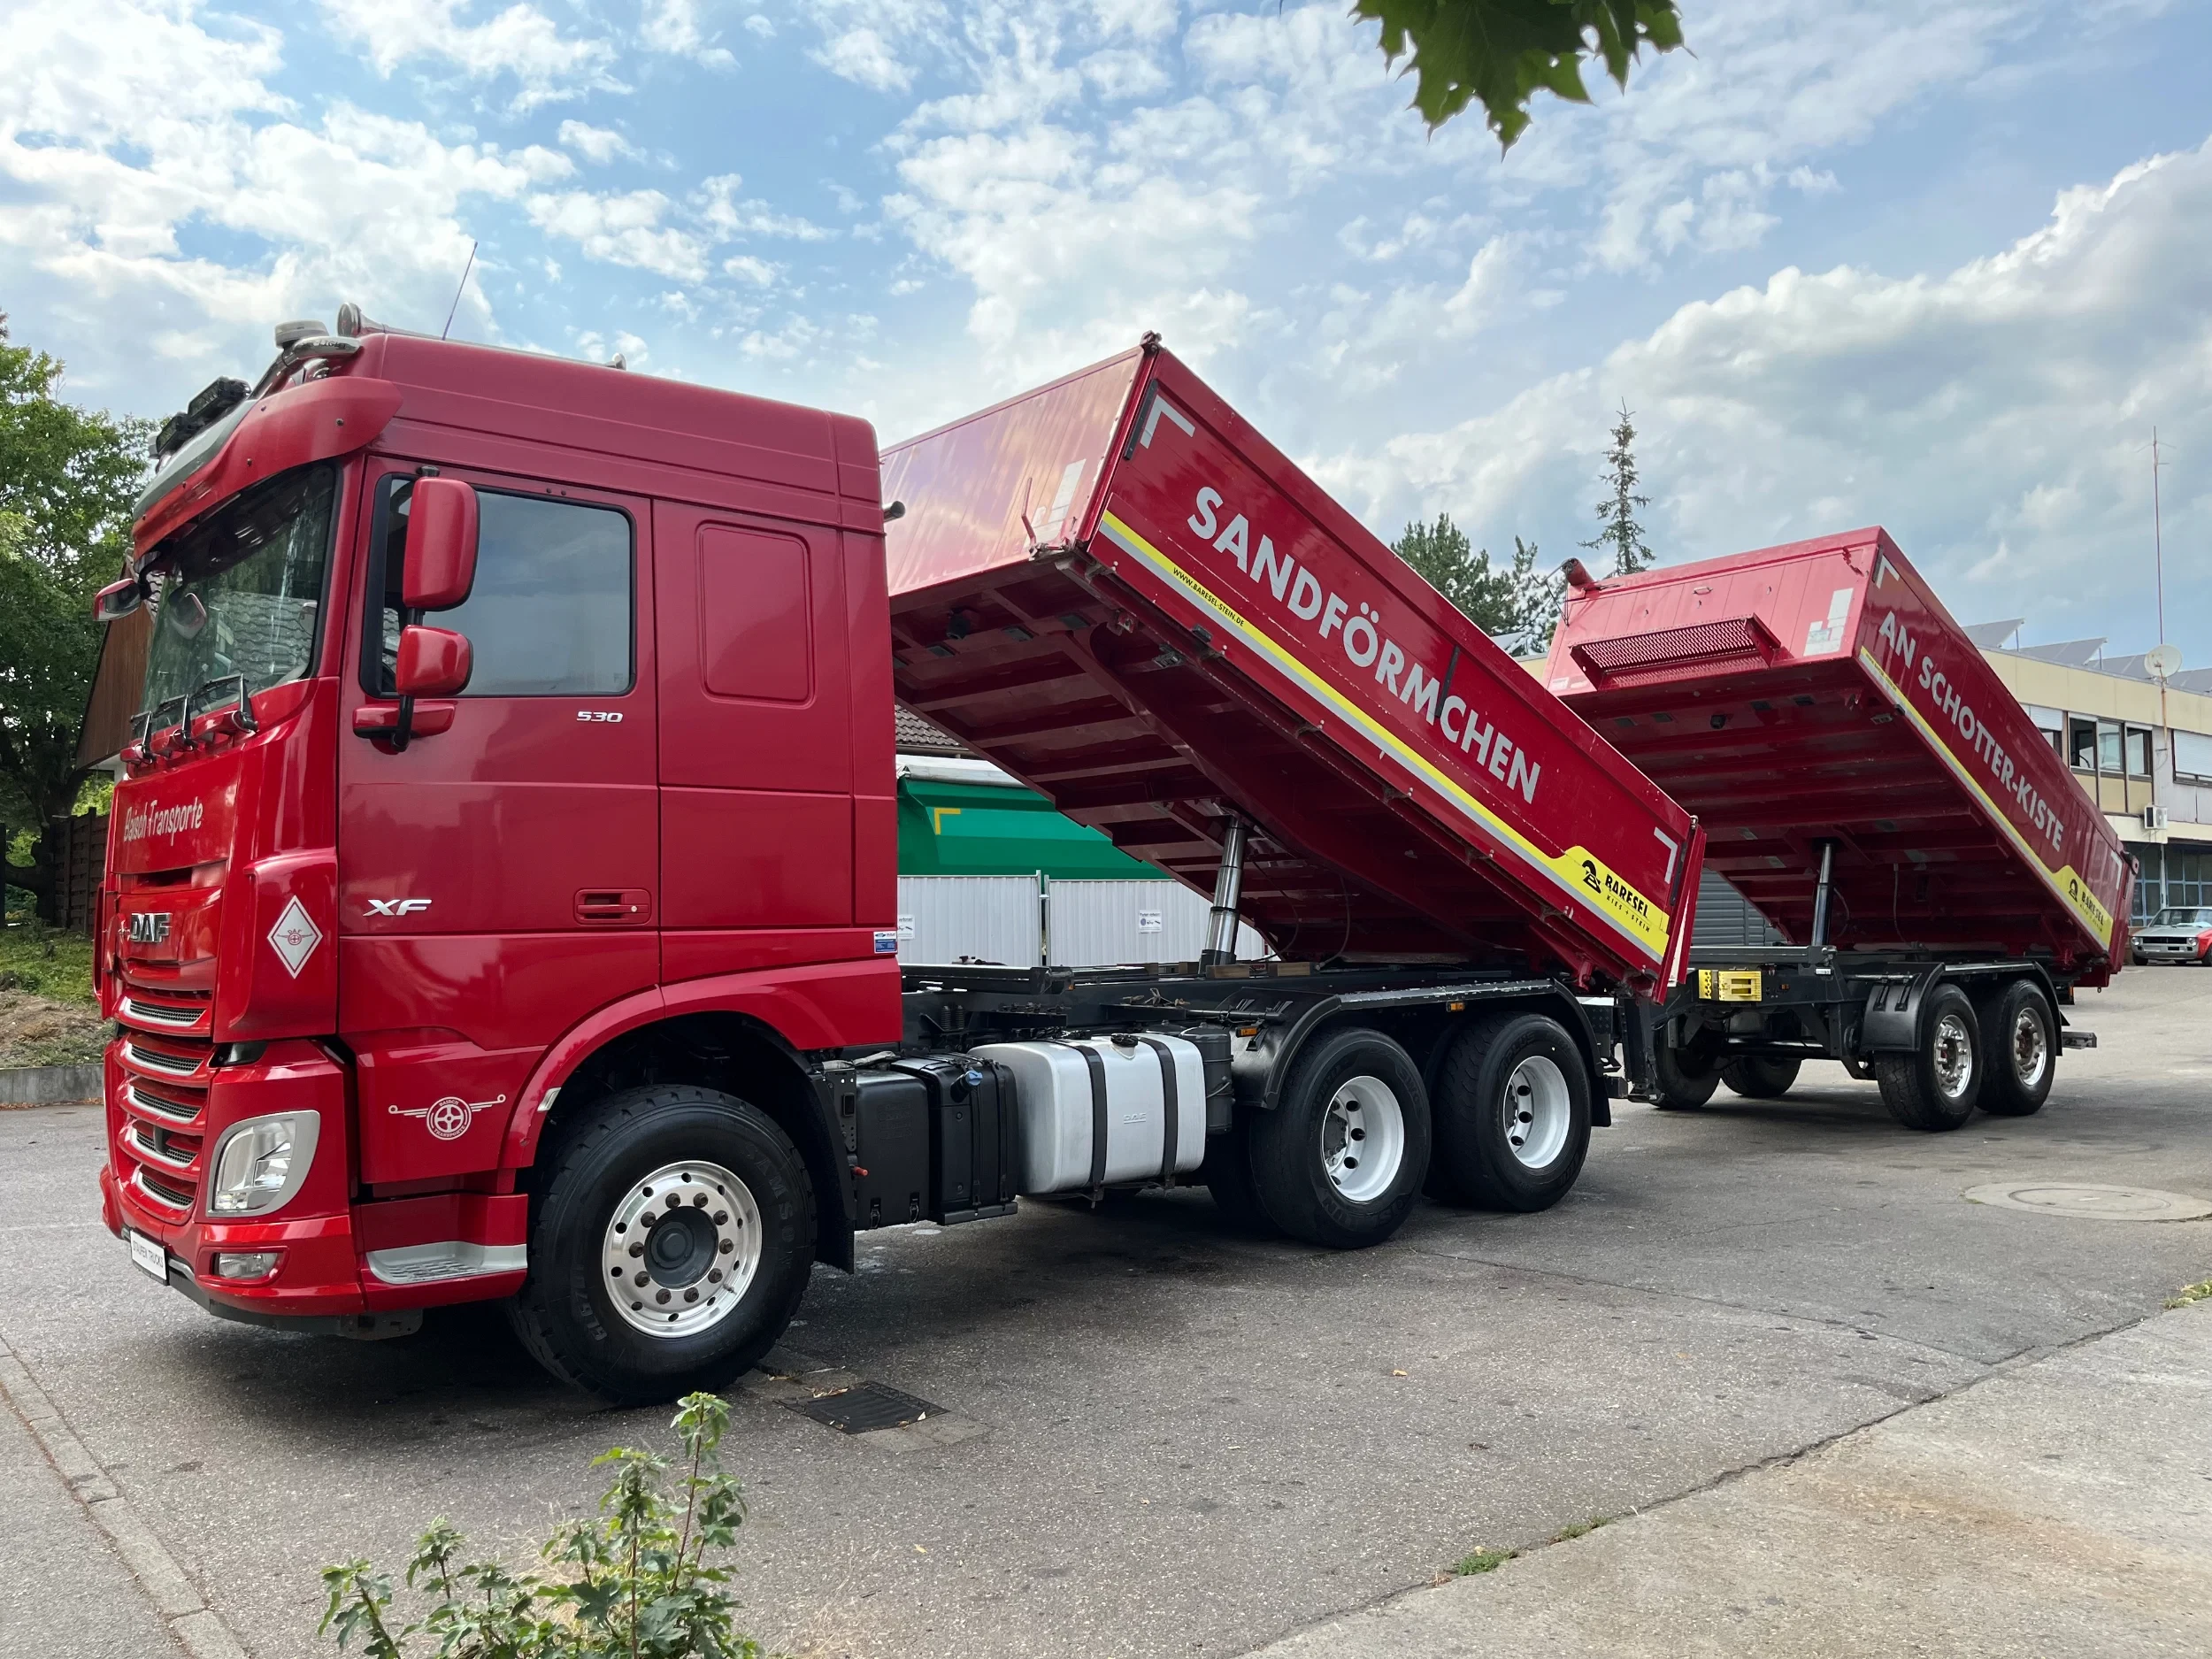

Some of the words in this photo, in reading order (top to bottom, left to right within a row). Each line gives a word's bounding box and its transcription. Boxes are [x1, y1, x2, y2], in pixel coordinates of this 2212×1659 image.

[1172, 566, 1245, 627] WWW.BARESEL-STEIN.DE
[1187, 486, 1541, 804] SANDFÖRMCHEN
[576, 710, 624, 723] 530
[1878, 611, 1916, 669] AN
[1918, 656, 2064, 852] SCHOTTER-KISTE
[148, 796, 204, 847] Transporte
[362, 898, 433, 917] XF
[1604, 873, 1648, 918] BARESEL
[1606, 895, 1623, 910] KIES
[1631, 914, 1650, 933] STEIN
[130, 912, 173, 943] DAF
[434, 1125, 466, 1138] TRANSPORTE
